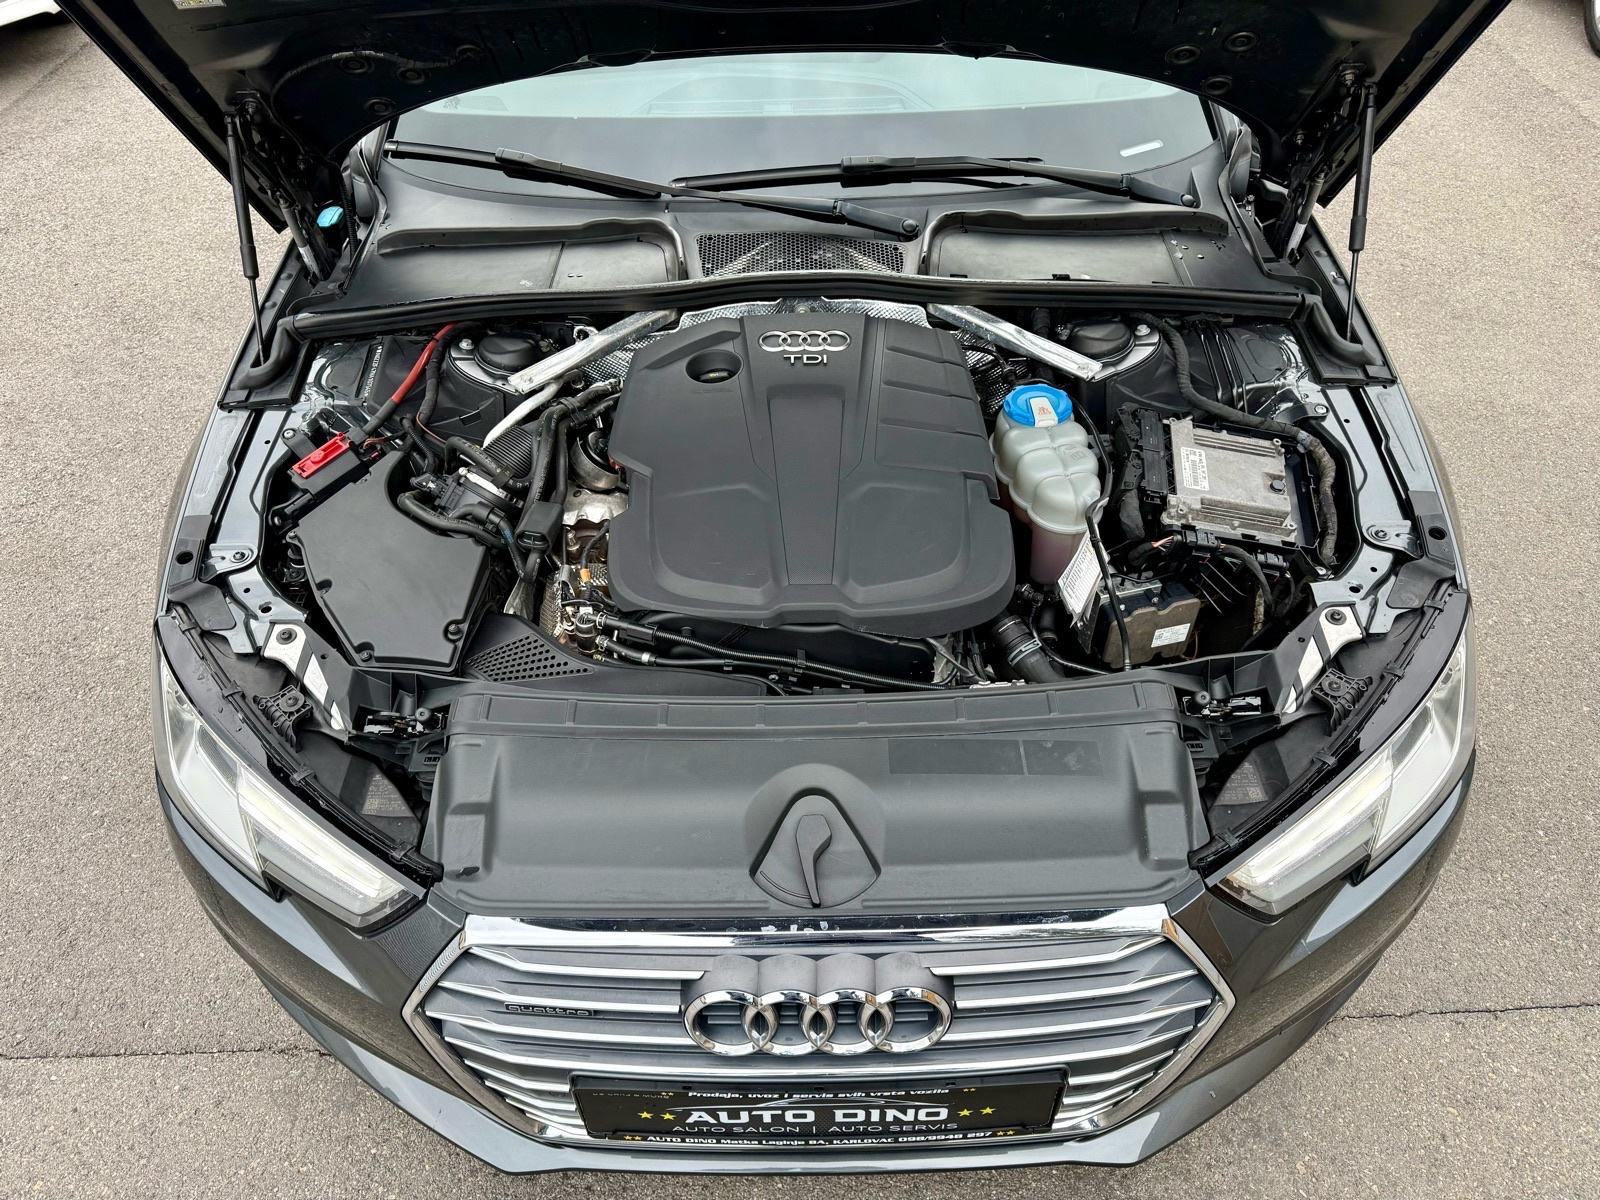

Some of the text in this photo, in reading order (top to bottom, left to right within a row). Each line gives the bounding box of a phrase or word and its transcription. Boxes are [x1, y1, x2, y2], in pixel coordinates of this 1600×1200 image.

[783, 354, 828, 364] TDI
[508, 1004, 590, 1016] quattro
[685, 1107, 949, 1124] AUTO DINO
[672, 1125, 726, 1133] AUTO
[828, 1125, 883, 1133] AUTO
[889, 1122, 959, 1132] SERVIS
[647, 1135, 682, 1143] AUTO
[685, 1136, 717, 1144] DINO
[832, 1137, 895, 1145] KARLOVAC
[966, 1131, 993, 1139] 297
